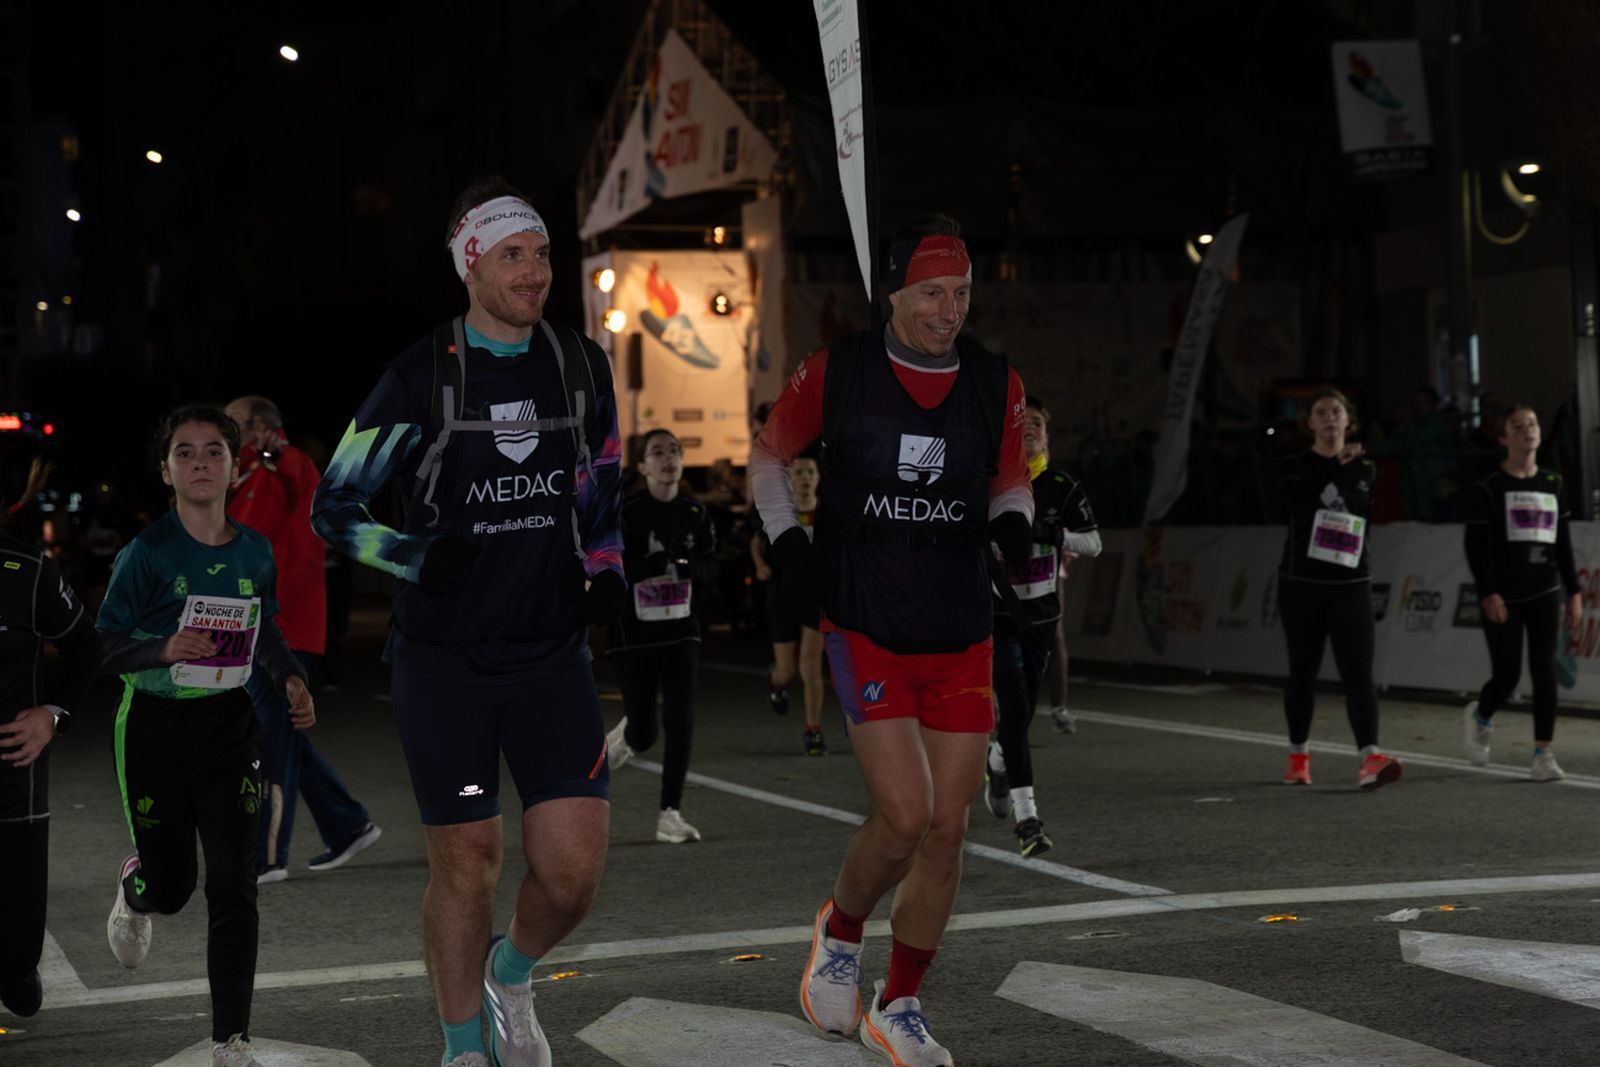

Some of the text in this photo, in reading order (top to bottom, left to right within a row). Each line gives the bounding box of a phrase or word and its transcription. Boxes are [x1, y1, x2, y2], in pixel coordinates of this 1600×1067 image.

[465, 469, 565, 504] MEDAC
[863, 492, 967, 523] MEDAC
[472, 514, 557, 535] #FamiliaMEDA
[191, 616, 212, 627] SAN
[204, 607, 233, 618] NOCHE
[233, 609, 245, 619] DE
